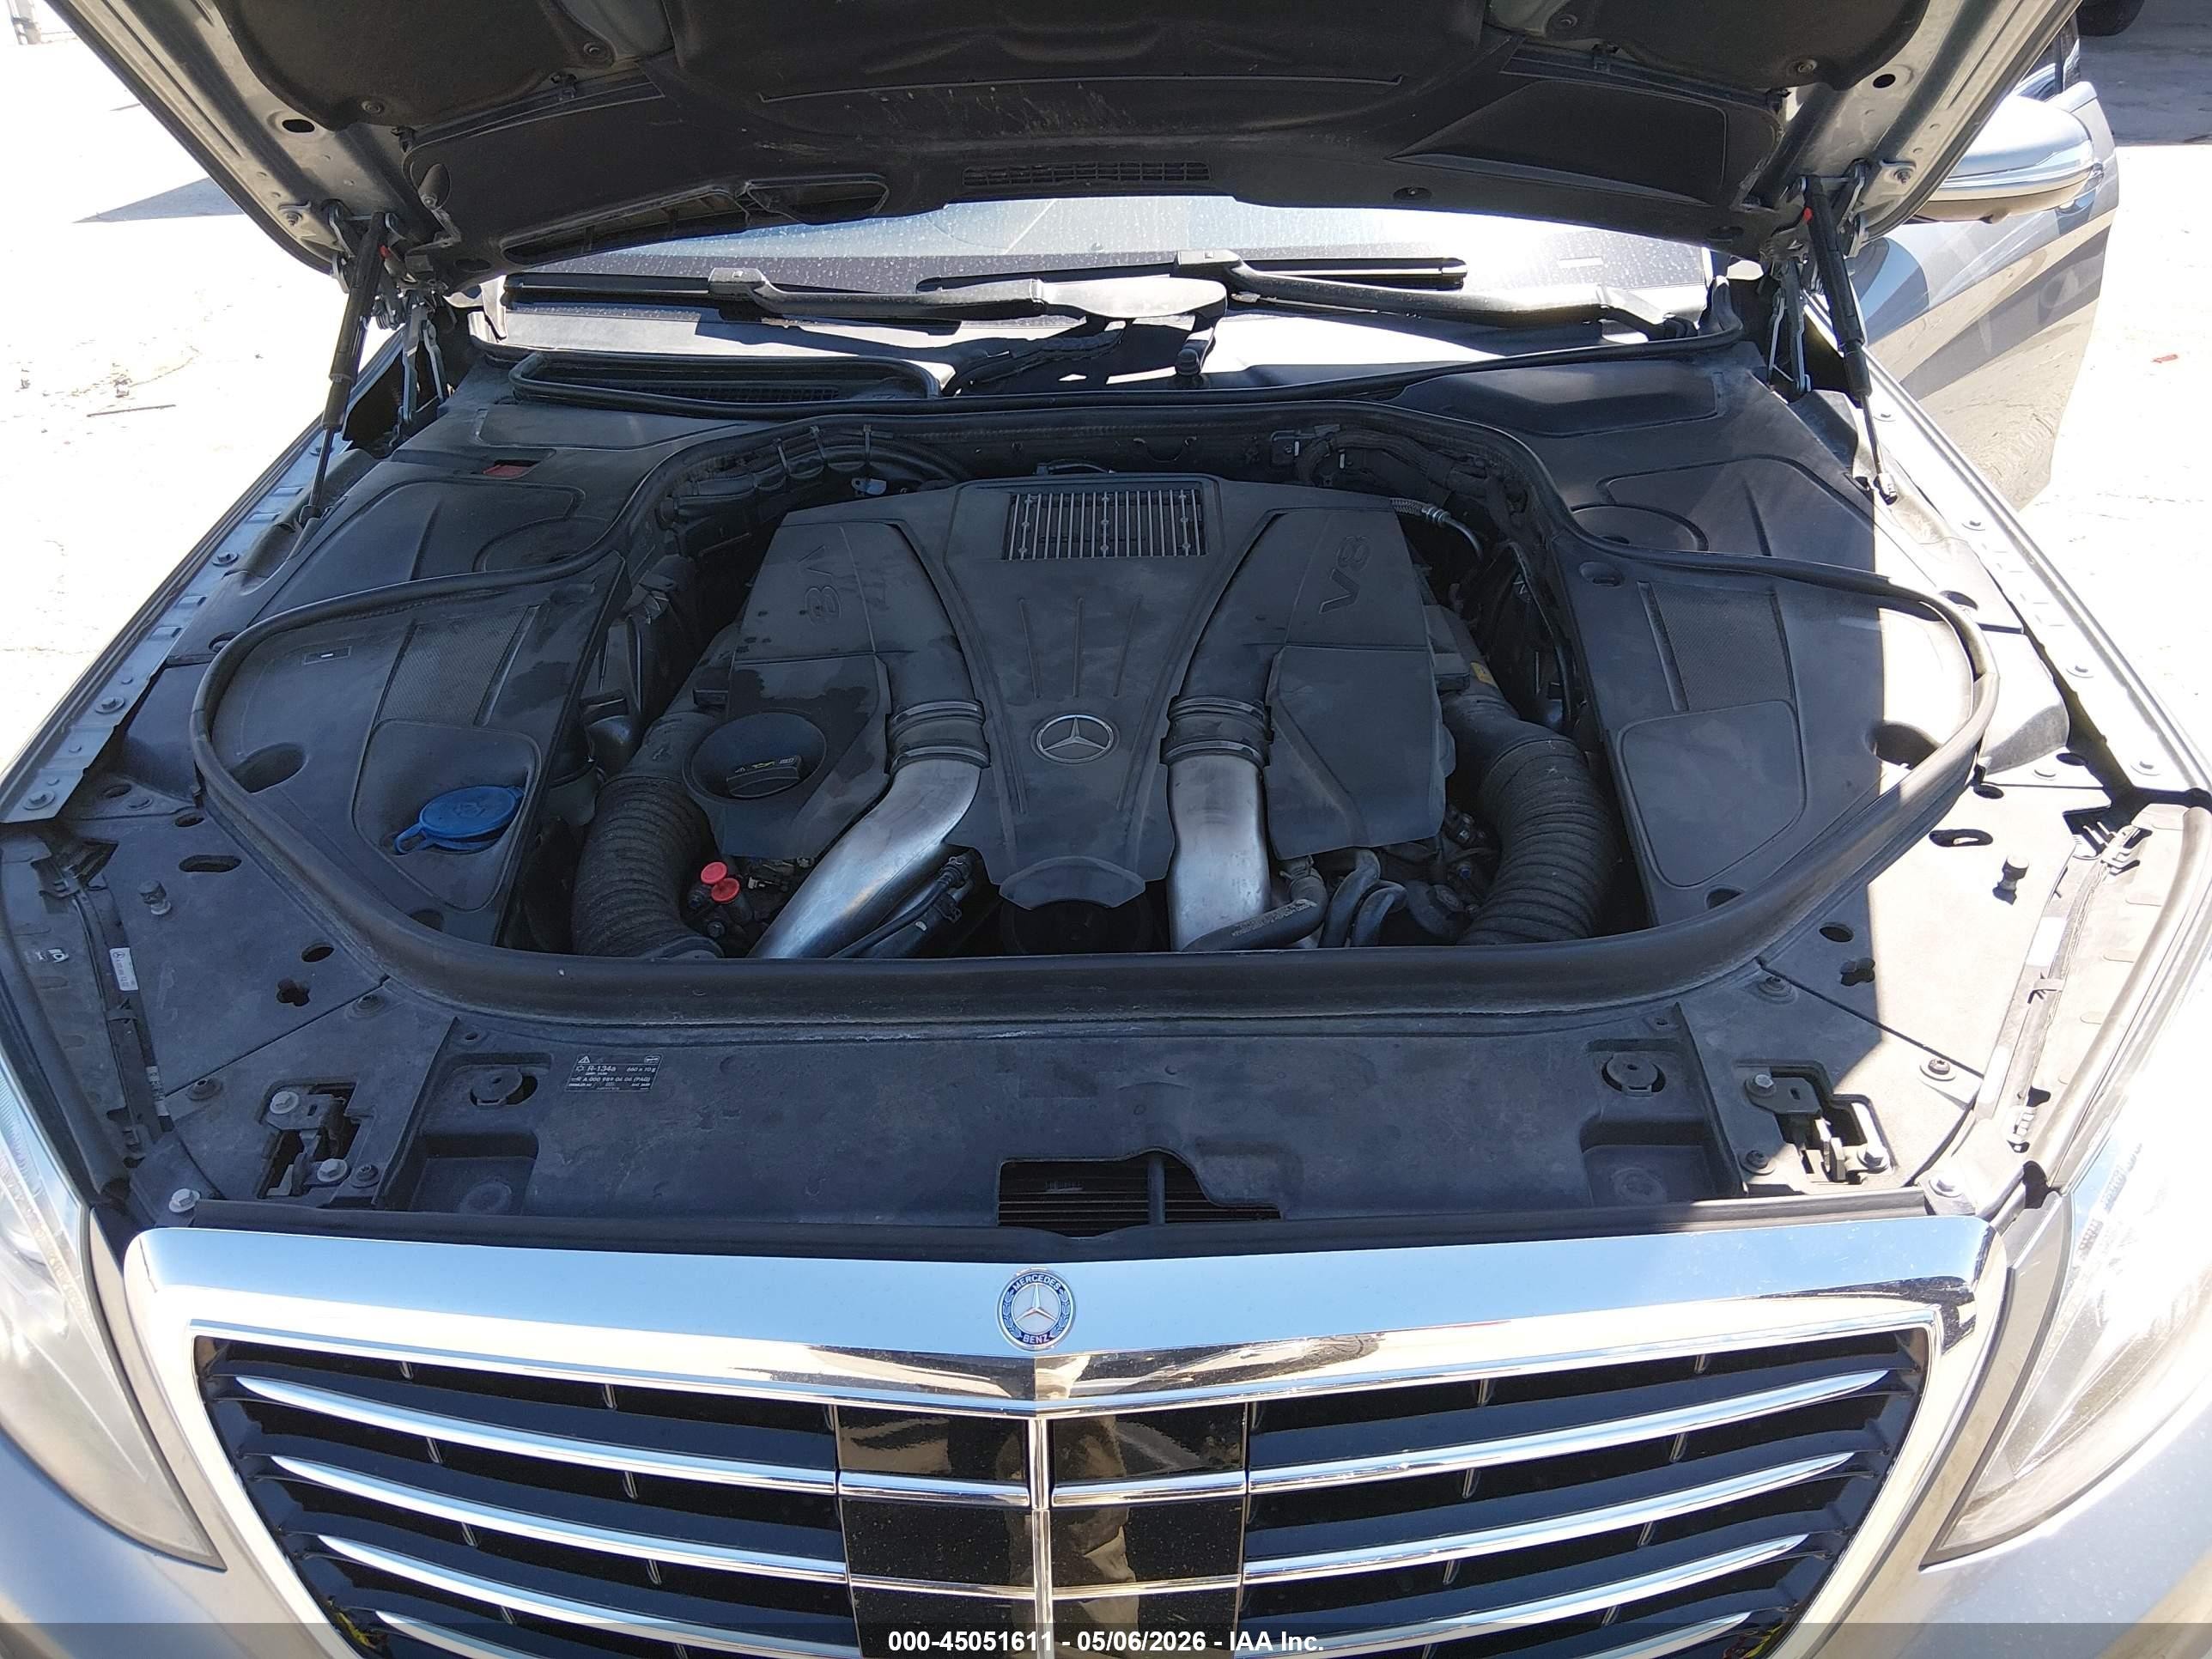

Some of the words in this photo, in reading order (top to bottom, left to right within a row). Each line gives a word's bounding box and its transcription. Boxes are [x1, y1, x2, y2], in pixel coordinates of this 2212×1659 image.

[796, 542, 842, 626] V8
[1318, 534, 1373, 615] V8
[1012, 1274, 1060, 1291] MERCEDES
[1023, 1334, 1049, 1344] BENZ
